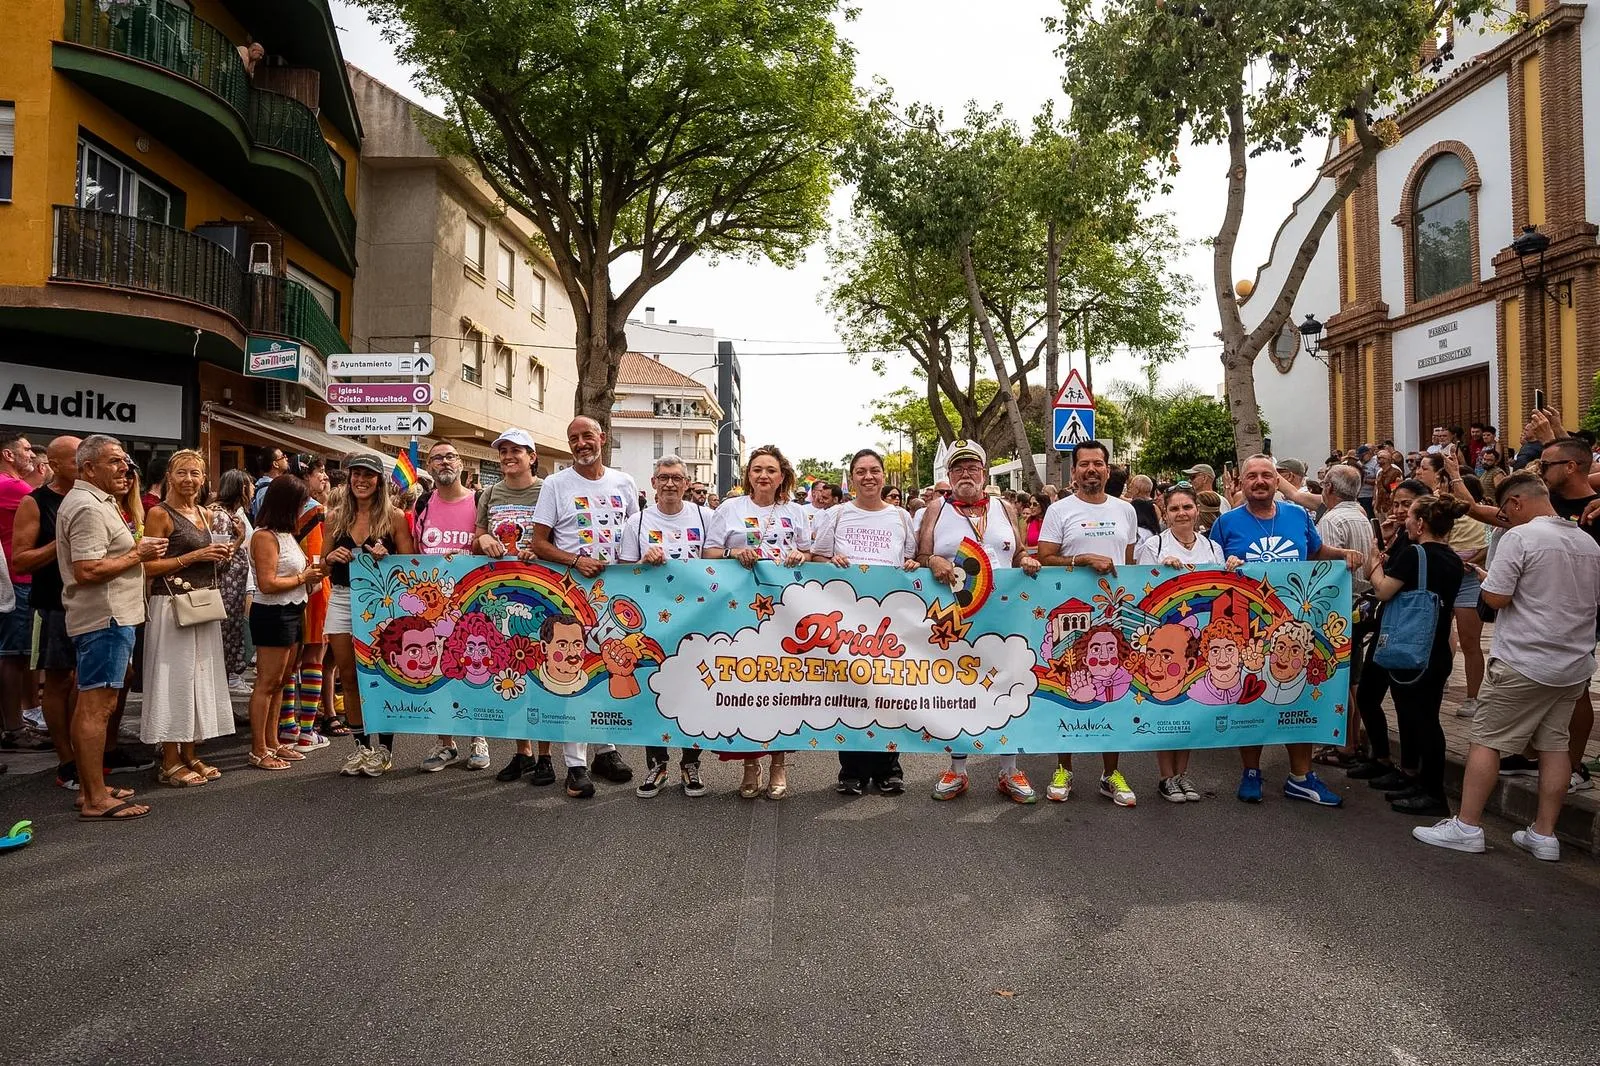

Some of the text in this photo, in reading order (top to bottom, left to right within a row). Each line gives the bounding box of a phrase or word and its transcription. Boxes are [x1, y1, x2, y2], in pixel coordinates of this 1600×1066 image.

[340, 361, 392, 369] Ayuntamiento
[338, 387, 363, 395] Iglesia
[2, 383, 137, 423] Audika
[338, 395, 408, 403] Cristo Resucitado
[338, 416, 377, 424] Mercadillo
[856, 528, 892, 536] ORGULLO
[781, 610, 906, 659] Pride
[715, 655, 981, 686] TORREMOLINOS
[716, 692, 977, 710] Donde se siembra cultura, florece la libertad
[1279, 710, 1309, 718] TORRE
[1278, 717, 1318, 725] MOLINOS
